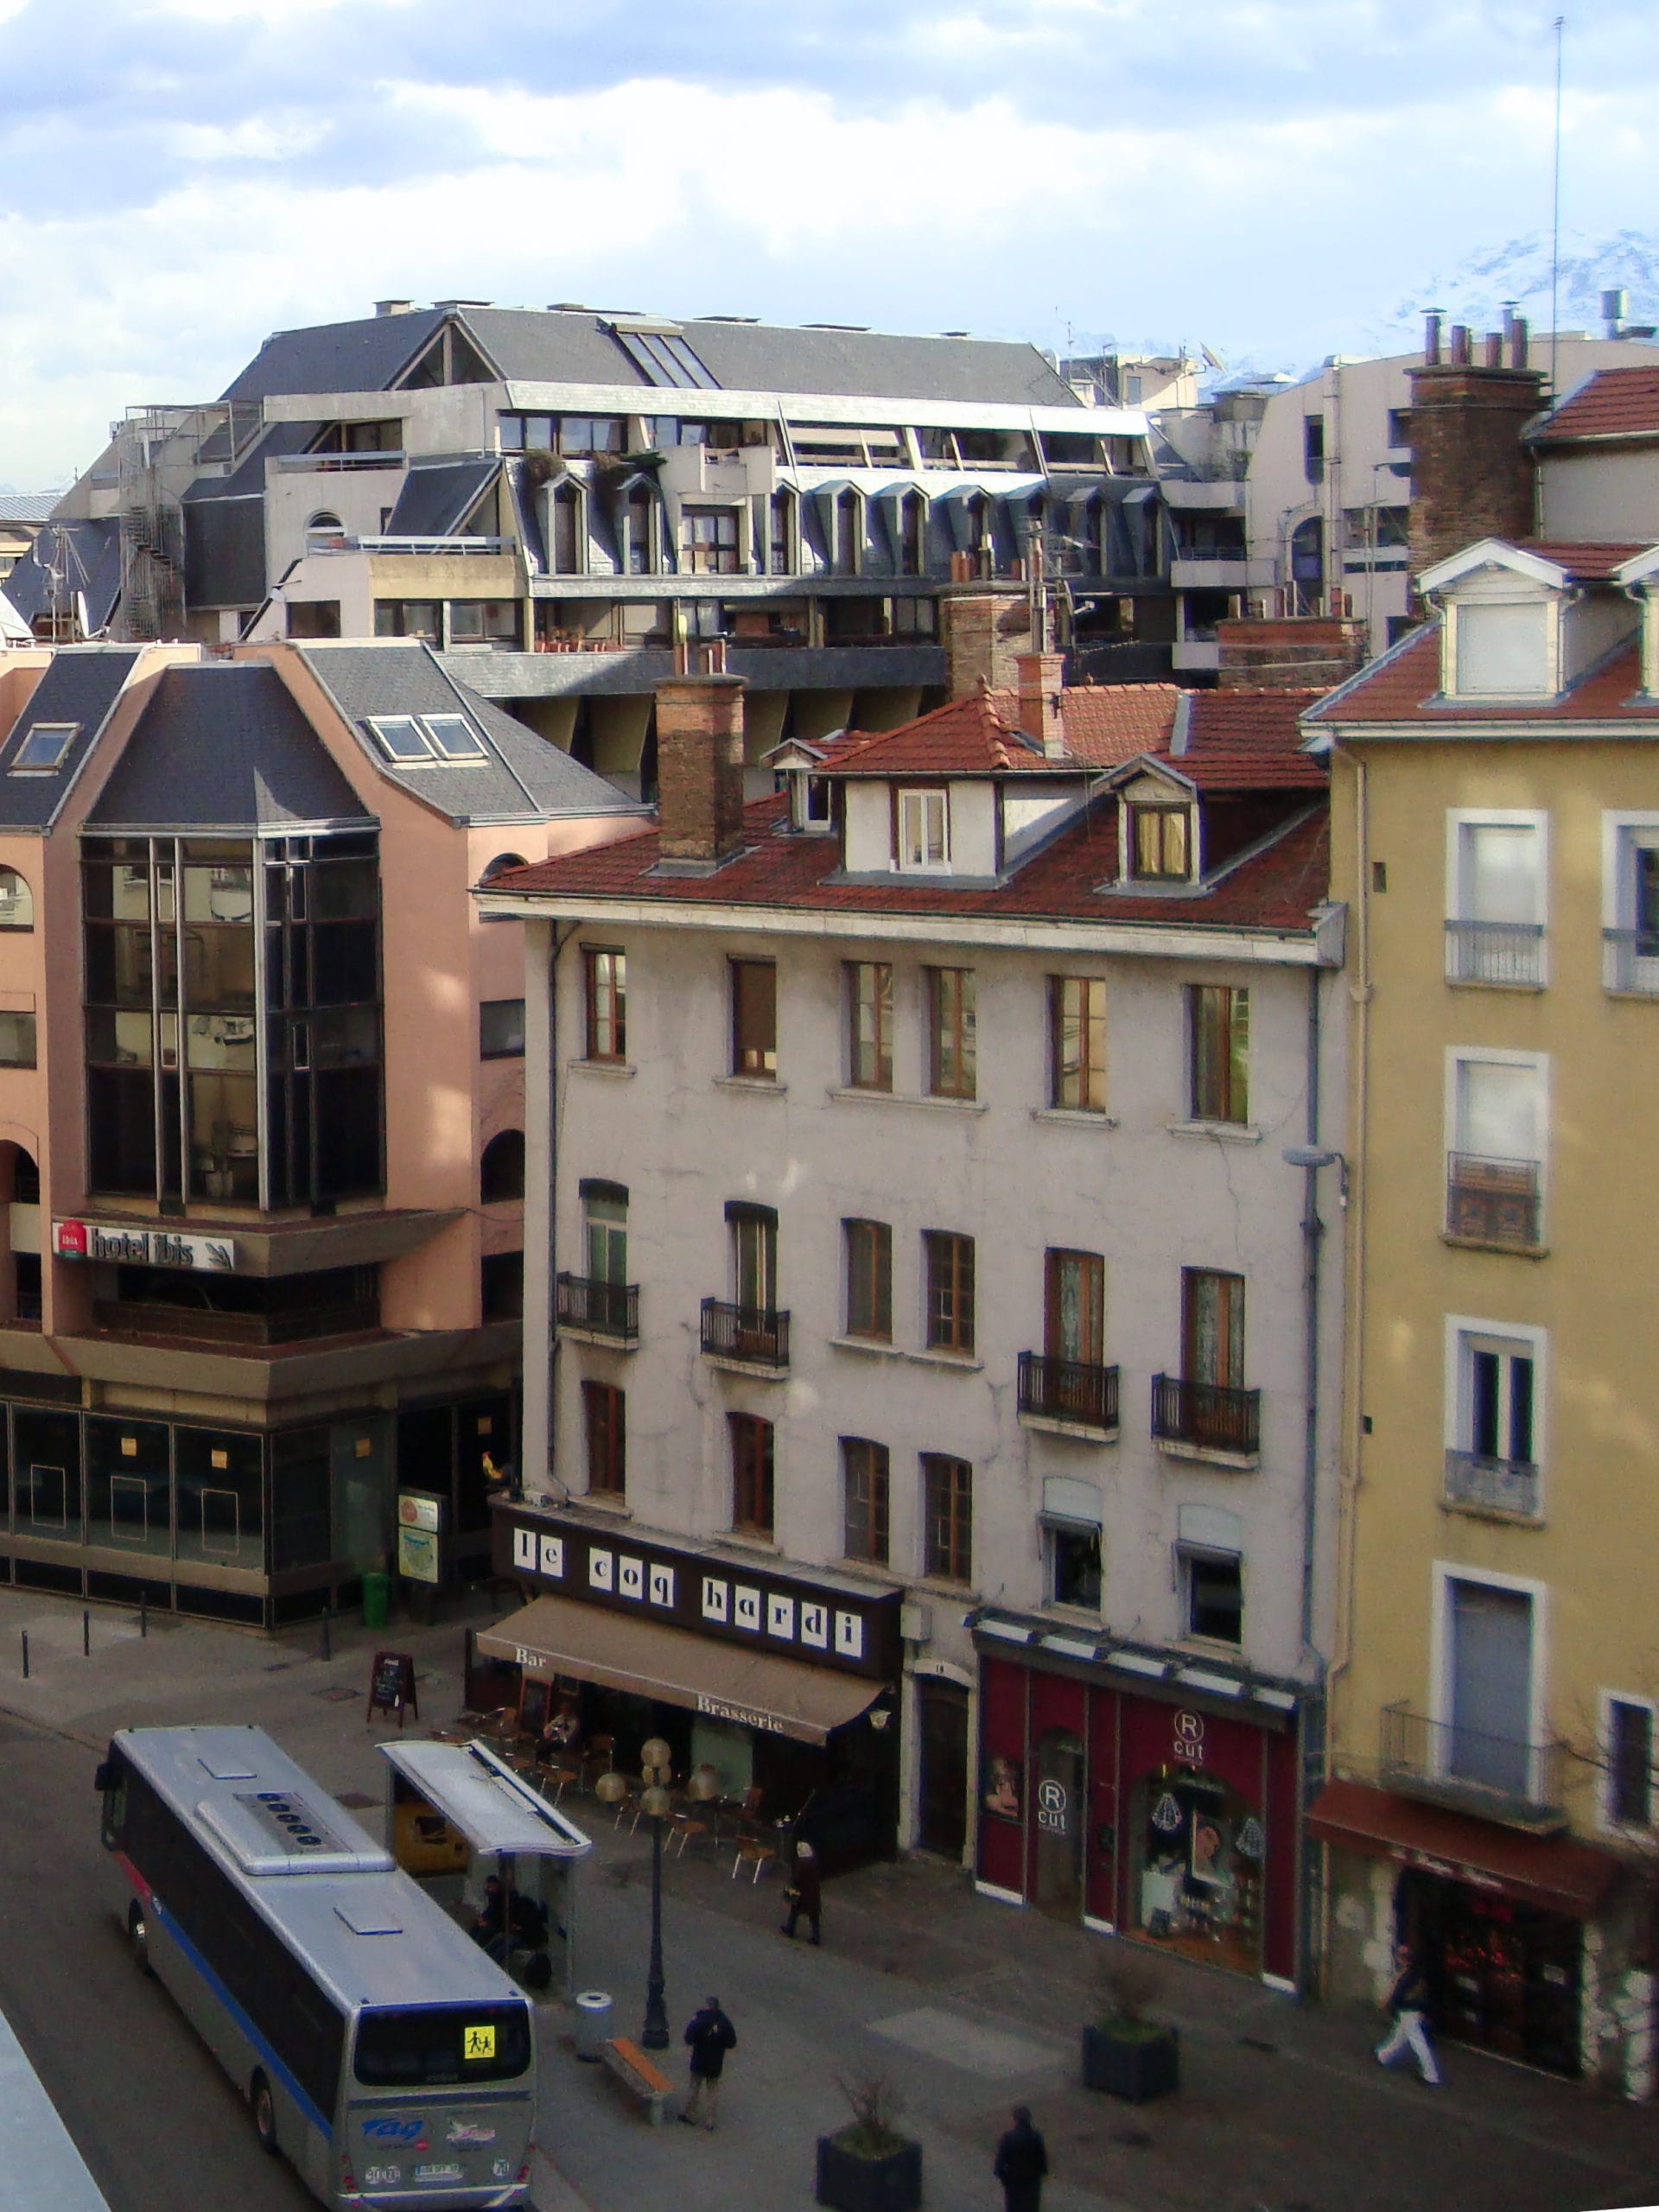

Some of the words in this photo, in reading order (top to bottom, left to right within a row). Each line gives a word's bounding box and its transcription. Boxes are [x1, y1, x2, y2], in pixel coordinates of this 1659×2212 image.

[91, 1228, 149, 1262] hotel
[153, 1233, 194, 1266] ibis
[520, 1532, 558, 1565] le
[594, 1560, 669, 1605] coq
[706, 1580, 853, 1644] hardi
[515, 1646, 547, 1668] Bar
[696, 1694, 784, 1734] Brasserie
[1173, 1740, 1204, 1760] cut
[1038, 1810, 1066, 1830] cut
